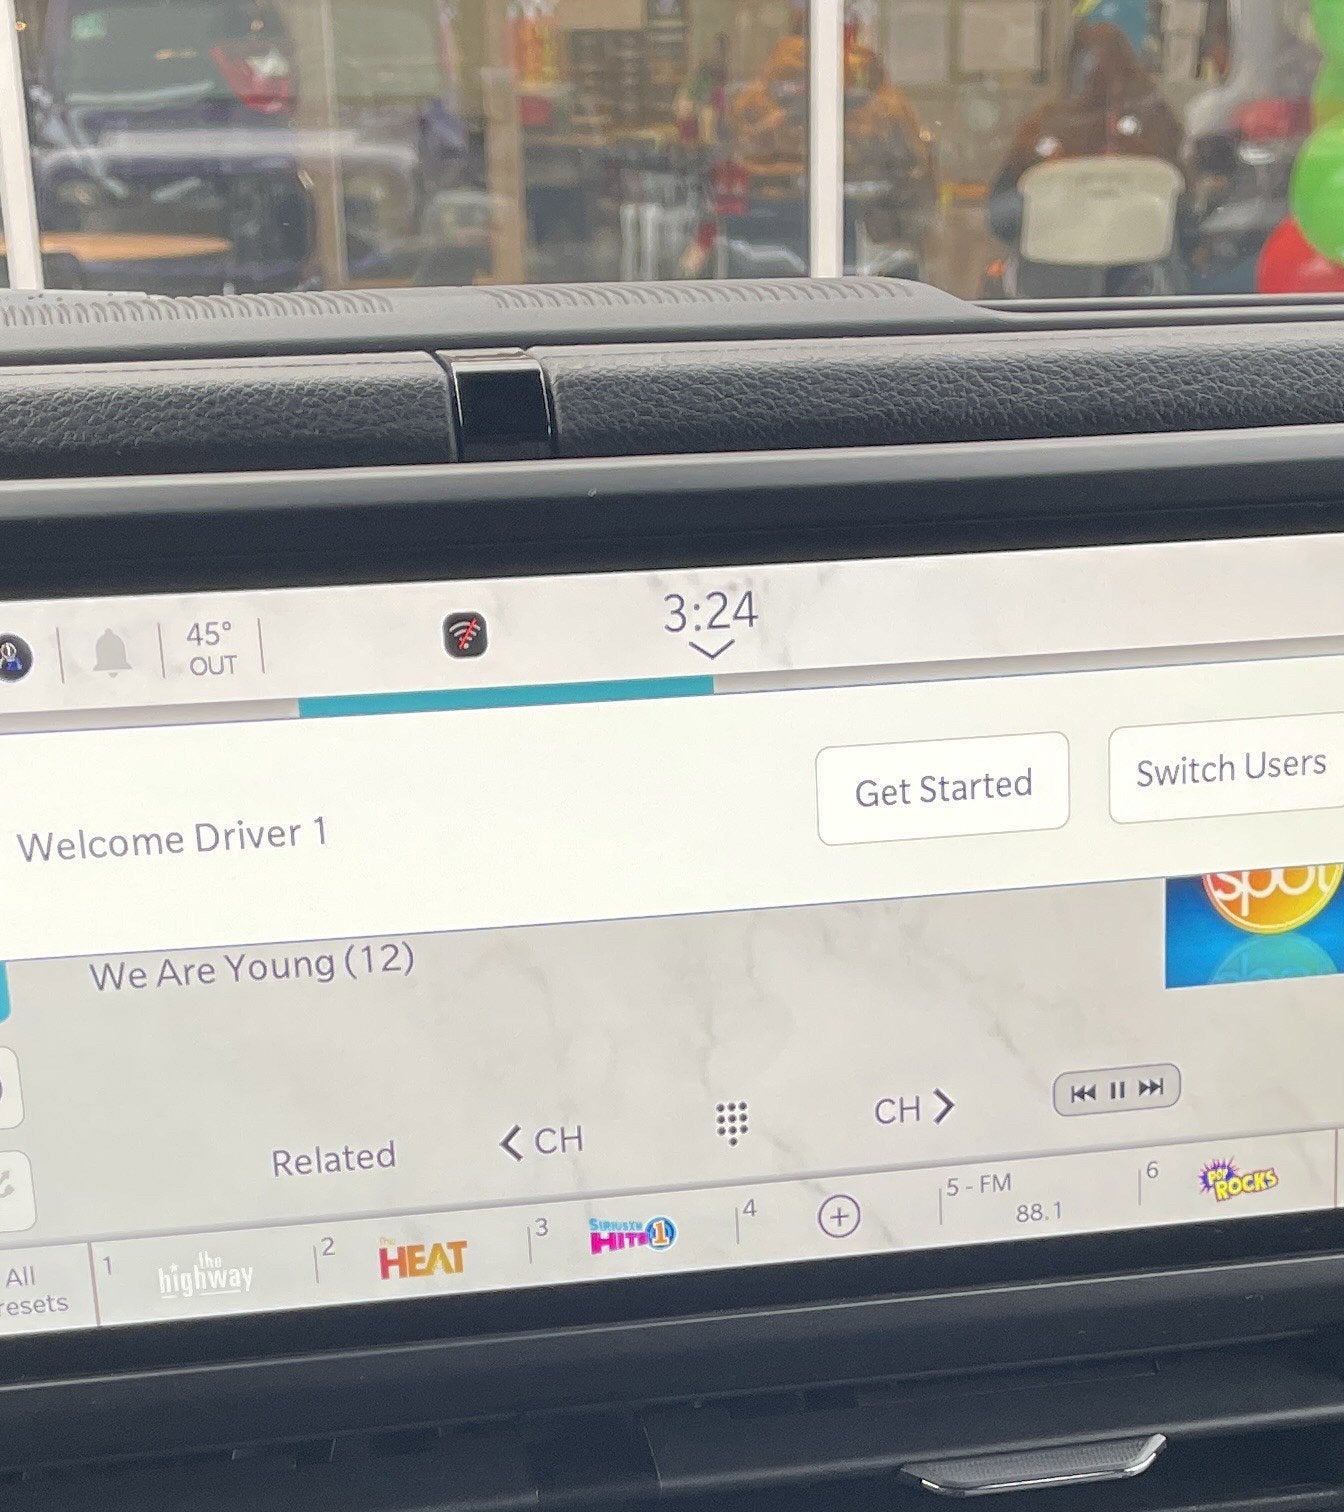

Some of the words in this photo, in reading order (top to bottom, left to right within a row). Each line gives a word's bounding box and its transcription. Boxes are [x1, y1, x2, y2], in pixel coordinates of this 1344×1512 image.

[664, 590, 759, 633] 3:24
[187, 621, 232, 646] 45°
[190, 655, 238, 677] OUT
[1136, 755, 1235, 788] Switch
[1245, 748, 1327, 780] Users
[856, 778, 912, 809] Get
[920, 768, 1034, 804] Started
[16, 825, 185, 864] Welcome
[196, 816, 302, 855] Driver
[313, 815, 327, 845] 1
[90, 962, 148, 992] We
[156, 957, 216, 988] Are
[225, 951, 336, 984] Young
[344, 941, 415, 979] (12)
[875, 1095, 920, 1124] CH
[535, 1126, 583, 1155] CH
[272, 1141, 396, 1177] Related
[1147, 1161, 1158, 1180] 6
[947, 1177, 958, 1196] 5
[980, 1173, 1011, 1194] FM
[1216, 1169, 1278, 1200] ROCKS
[743, 1199, 756, 1217] 4
[1016, 1202, 1062, 1223] 88.1
[535, 1218, 548, 1236] 3
[653, 1220, 669, 1245] 1
[198, 1250, 222, 1268] the
[321, 1237, 335, 1256] 2
[103, 1256, 112, 1276] 1
[379, 1240, 467, 1280] HEAT
[5, 1265, 36, 1288] All
[158, 1264, 253, 1297] highway
